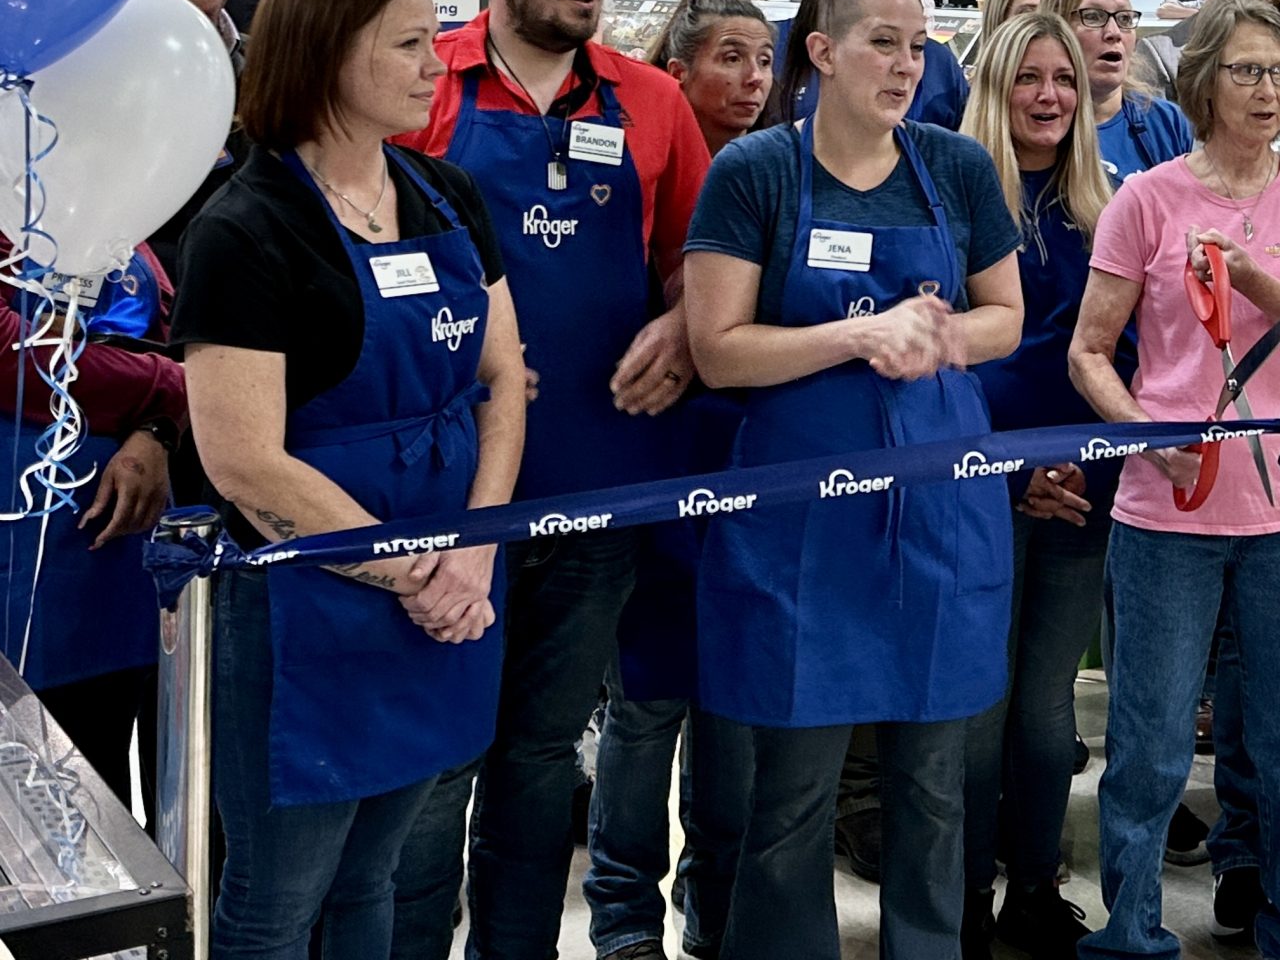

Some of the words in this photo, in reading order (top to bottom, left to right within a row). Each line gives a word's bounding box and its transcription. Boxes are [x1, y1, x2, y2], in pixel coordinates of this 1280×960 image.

[434, 2, 459, 17] ing
[575, 135, 618, 149] BRANDON
[523, 205, 579, 248] Kroger
[827, 244, 852, 254] JENA
[431, 307, 479, 351] Kroger
[953, 451, 1024, 480] Kroger
[818, 468, 894, 498] Kroger
[678, 488, 757, 517] Kroger
[529, 513, 613, 538] Kroger
